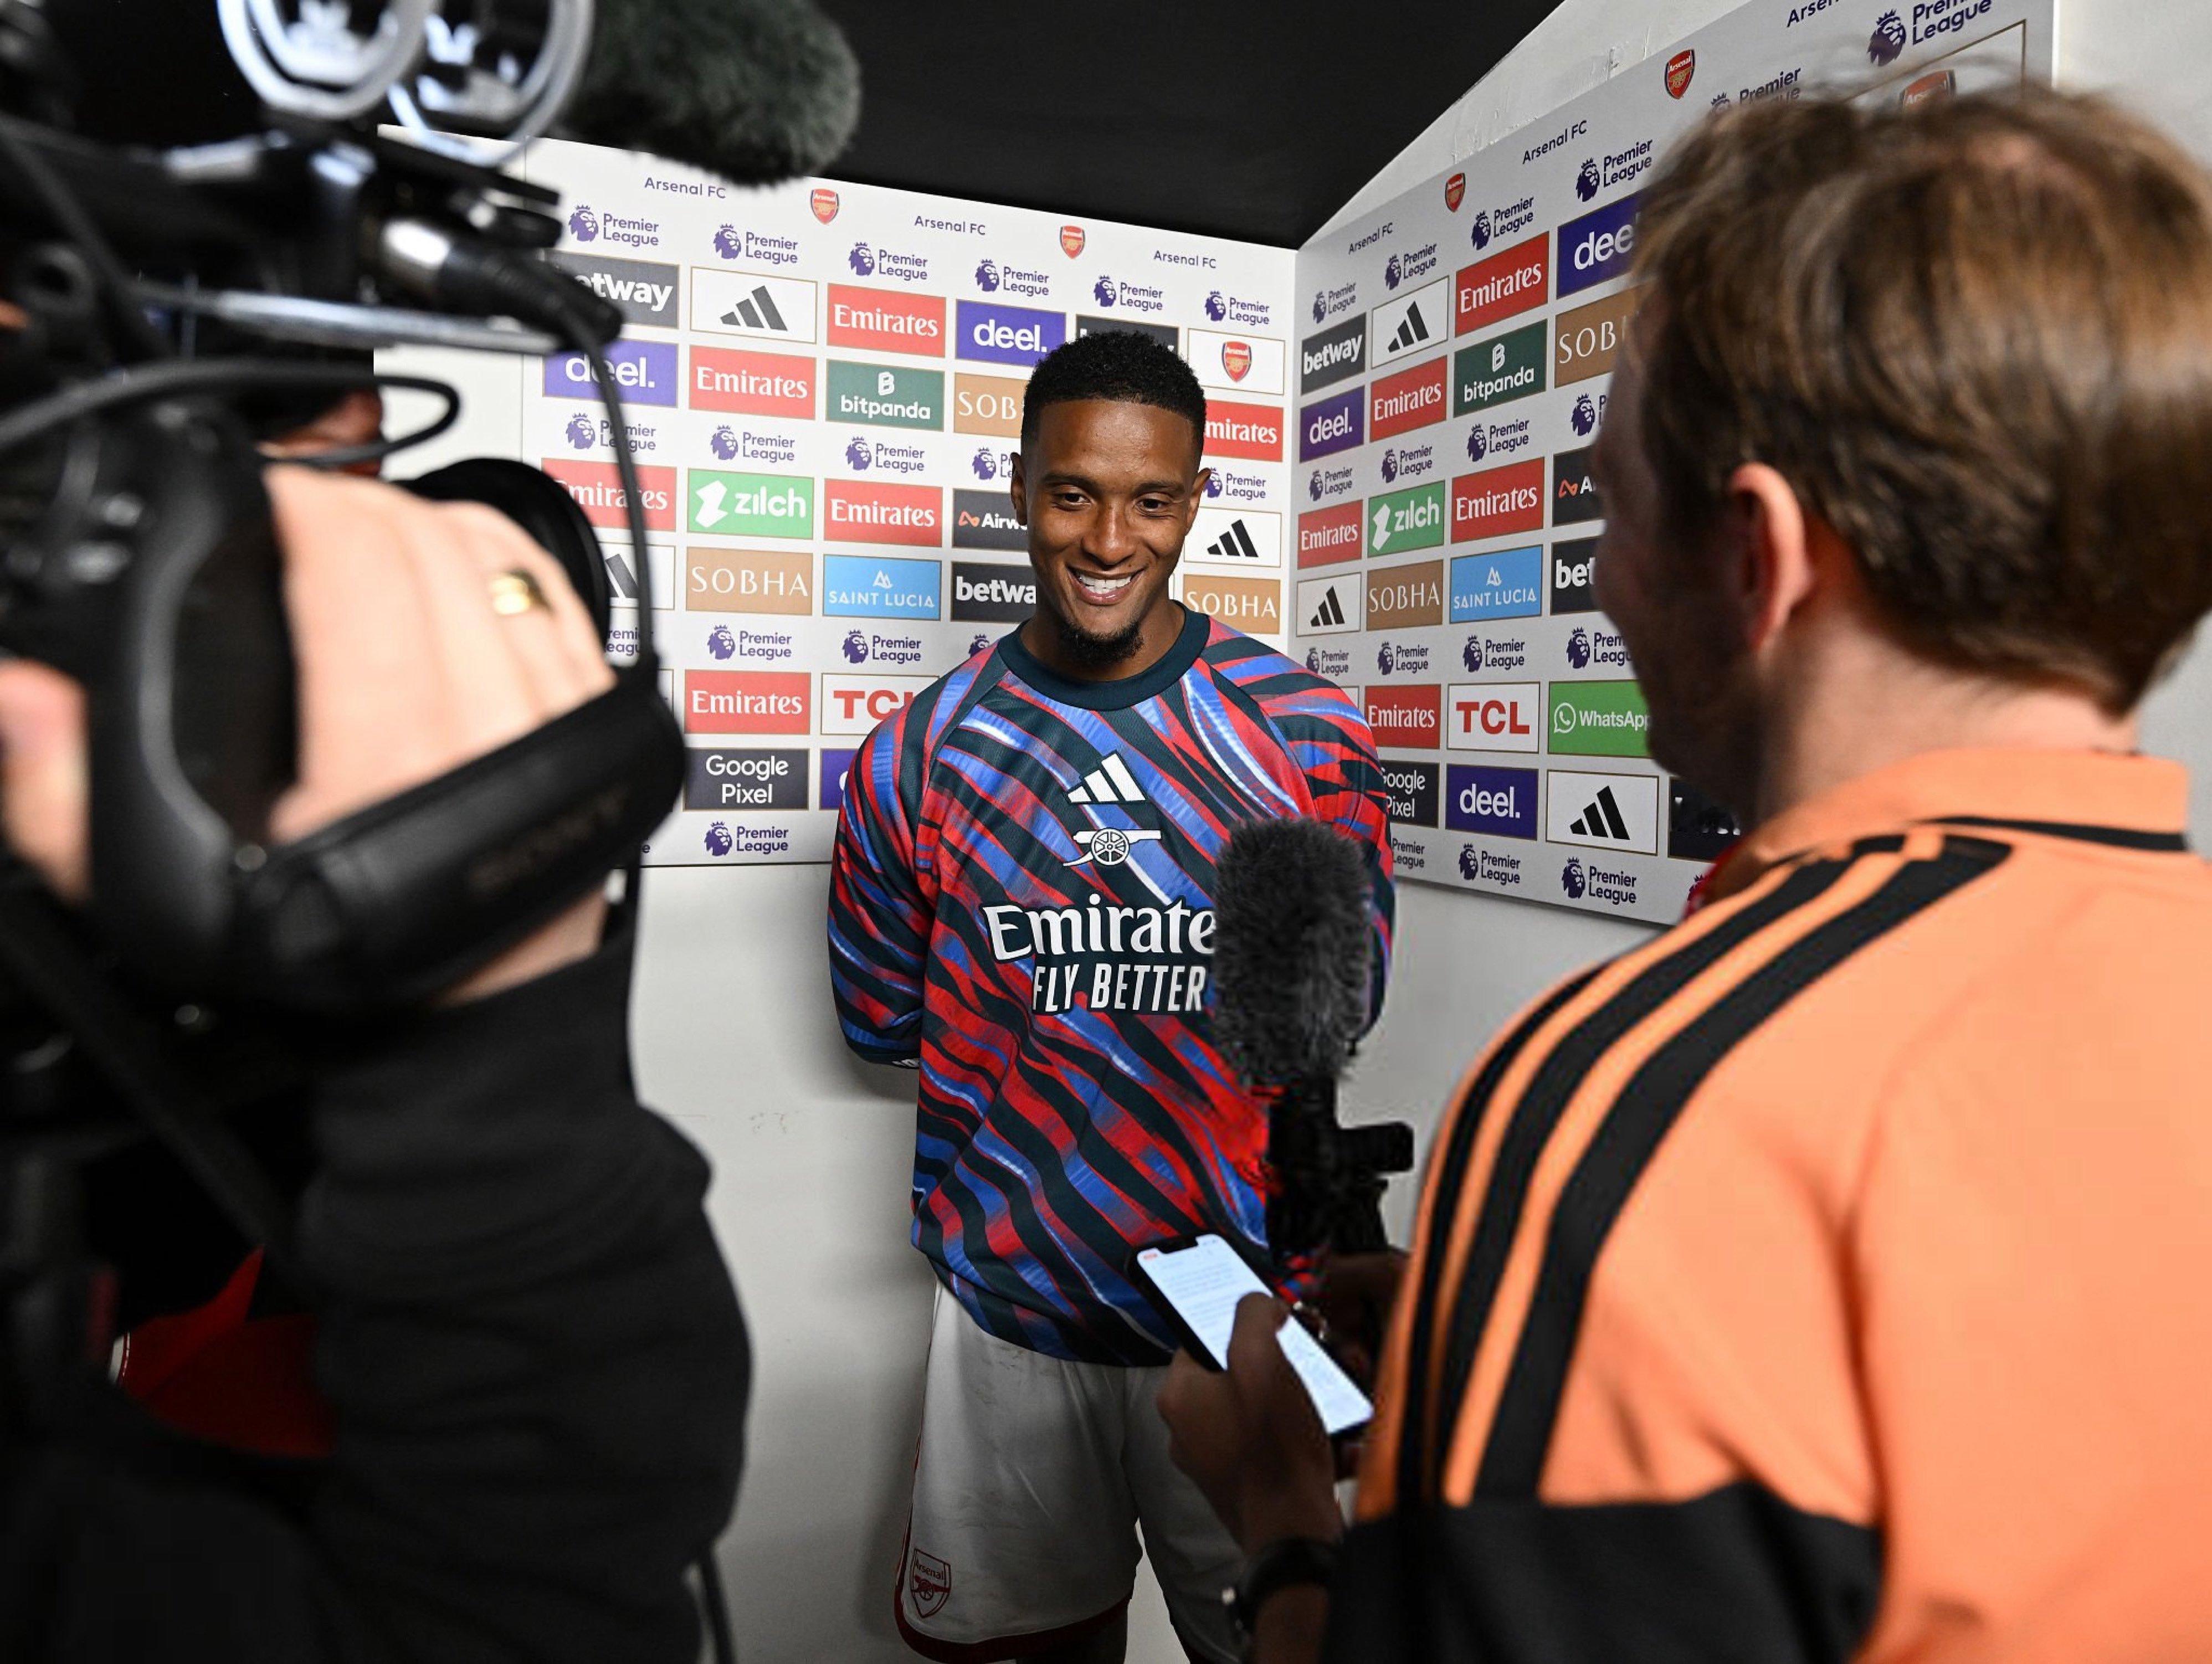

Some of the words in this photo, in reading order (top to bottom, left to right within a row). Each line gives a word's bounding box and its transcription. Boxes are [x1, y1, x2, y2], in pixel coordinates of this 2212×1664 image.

[1913, 0, 1992, 45] League
[1667, 55, 1692, 74] Arsenal
[1522, 131, 1568, 165] Arsenal
[1571, 120, 1588, 142] FC
[1604, 139, 1653, 172] Premier
[1604, 155, 1652, 188] League
[645, 177, 703, 197] Arsenal
[707, 184, 726, 199] FC
[1494, 196, 1534, 222] Premier
[603, 213, 659, 232] Premier
[915, 215, 966, 233] Arsenal
[970, 223, 986, 235] FC
[1494, 210, 1534, 238] League
[603, 229, 659, 246] League
[746, 232, 798, 250] Premier
[1348, 230, 1380, 254] Arsenal
[1382, 222, 1393, 238] FC
[1574, 222, 1635, 270] dee
[746, 248, 798, 264] League
[879, 250, 927, 267] Premier
[1154, 250, 1199, 266] Arsenal
[1203, 257, 1217, 269] FC
[1404, 243, 1436, 265] Premier
[879, 265, 927, 281] League
[1003, 267, 1049, 283] Premier
[1404, 256, 1436, 279] League
[576, 273, 673, 311] tway
[1003, 280, 1049, 297] League
[1120, 283, 1163, 299] Premier
[1328, 281, 1356, 301] Premier
[1460, 263, 1542, 314] Emirates
[1120, 295, 1163, 311] League
[1230, 297, 1270, 313] Premier
[1328, 295, 1356, 314] League
[834, 305, 938, 337] Emirates
[1230, 311, 1270, 326] League
[974, 319, 1048, 353] deel.
[1559, 321, 1616, 363] SOB
[1303, 334, 1363, 375] betway
[696, 367, 807, 398] Emirates
[1464, 367, 1534, 403] bitpanda
[841, 396, 931, 420] bitpanda
[958, 391, 1017, 419] SOB
[1374, 383, 1441, 421] Emirates
[601, 420, 656, 437] Pmier
[1205, 418, 1277, 444] mirates
[1310, 407, 1353, 444] deel.
[1490, 419, 1529, 438] Premier
[743, 432, 795, 449] Premier
[1490, 434, 1529, 454] League
[743, 445, 795, 463] League
[876, 444, 925, 459] Premier
[1400, 445, 1433, 463] Premier
[876, 458, 925, 473] League
[1325, 468, 1352, 482] Premier
[1400, 458, 1433, 476] League
[1226, 473, 1266, 487] Premier
[1325, 479, 1352, 495] League
[556, 480, 668, 510] miraes
[1226, 486, 1266, 500] League
[830, 499, 935, 527] Emirates
[1456, 487, 1538, 521] Emirates
[1302, 523, 1358, 550] Emirates
[691, 566, 808, 597] SOBHA
[1556, 557, 1595, 589] bet
[829, 591, 879, 605] SAINT
[885, 593, 935, 608] LUCIA
[956, 576, 1036, 604] betwa
[1369, 581, 1440, 612] SOBHA
[1454, 591, 1490, 609] SAINT
[1495, 588, 1537, 606] LUCIA
[1187, 592, 1277, 618] SOBHA
[740, 631, 792, 645] Premier
[872, 636, 921, 650] Premier
[1486, 639, 1525, 654] Premier
[1594, 632, 1624, 647] Prem
[740, 645, 792, 660] League
[872, 648, 921, 663] League
[1322, 650, 1349, 662] Premier
[1397, 645, 1429, 659] Premier
[1486, 654, 1525, 669] League
[1594, 648, 1631, 666] Leagu
[1322, 662, 1349, 675] League
[1397, 659, 1429, 672] League
[692, 690, 803, 715] Emirates
[1368, 704, 1435, 728] Emirates
[1456, 700, 1530, 735] TCL
[706, 754, 789, 782] Google
[722, 784, 773, 804] Pixel
[1460, 783, 1521, 819] deel.
[737, 826, 789, 840] Premier
[737, 841, 789, 856] League
[1393, 838, 1425, 855] Premier
[1481, 850, 1521, 870] Premier
[1481, 866, 1521, 886] League
[1589, 866, 1637, 887] Premier
[1589, 884, 1637, 906] League
[982, 893, 1216, 961] Emirate
[1033, 964, 1080, 1013] FLY
[1090, 964, 1207, 1013] BETTER
